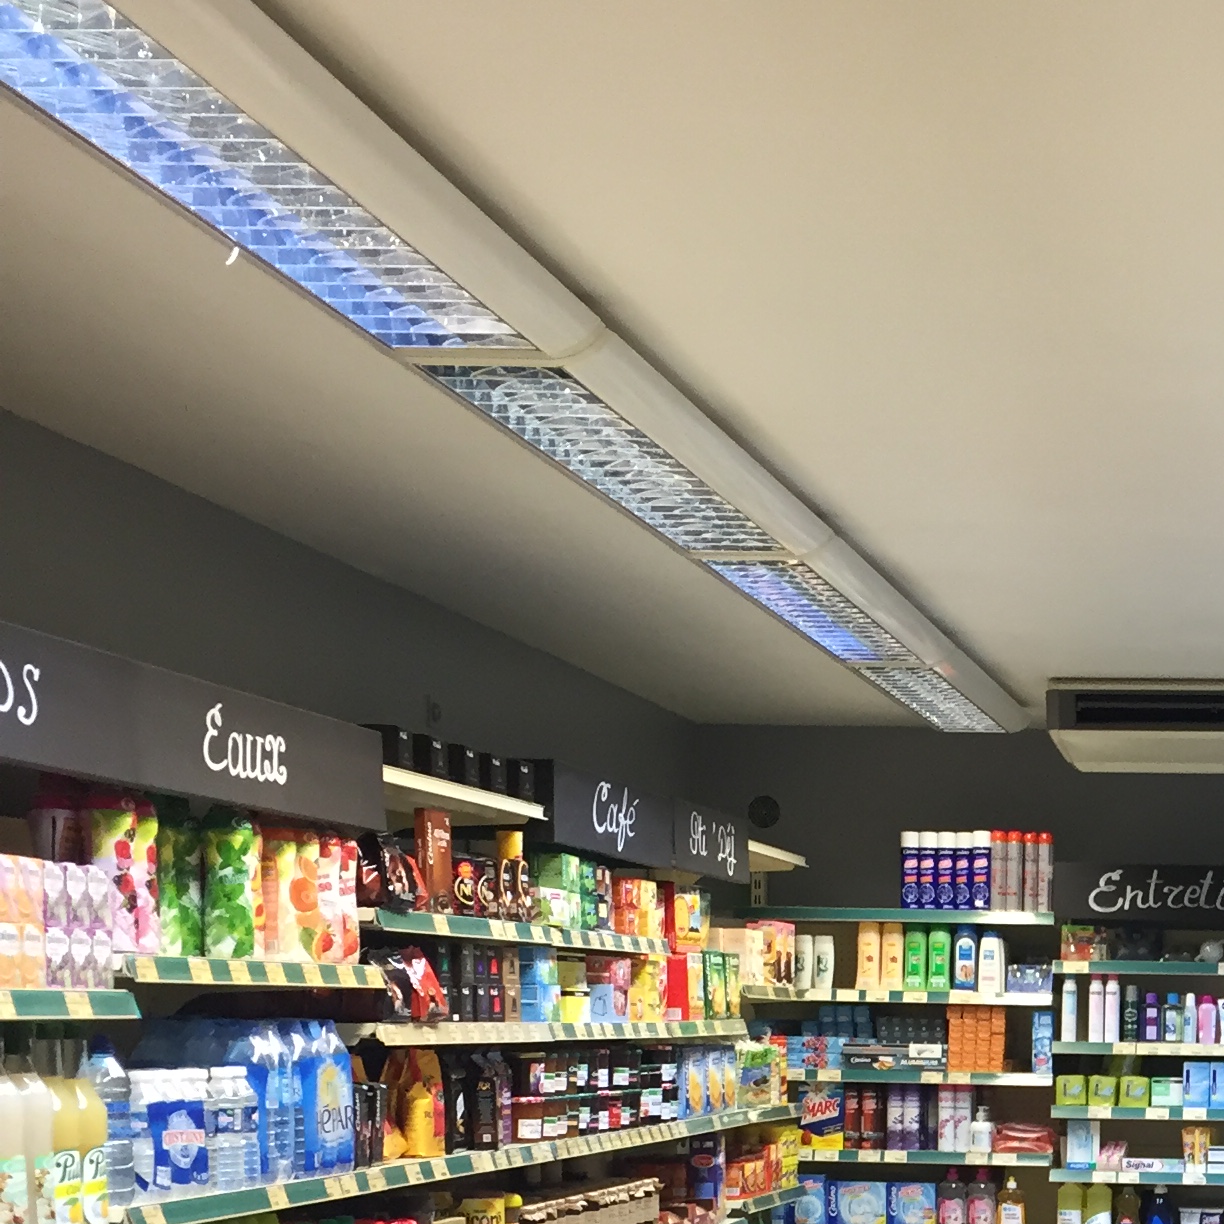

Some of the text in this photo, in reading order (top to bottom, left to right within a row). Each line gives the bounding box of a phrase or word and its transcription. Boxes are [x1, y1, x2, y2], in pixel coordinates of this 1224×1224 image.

[203, 703, 288, 785] Eaux
[592, 781, 640, 852] Café
[807, 1098, 840, 1118] MARC
[1125, 1160, 1154, 1170] Signal
